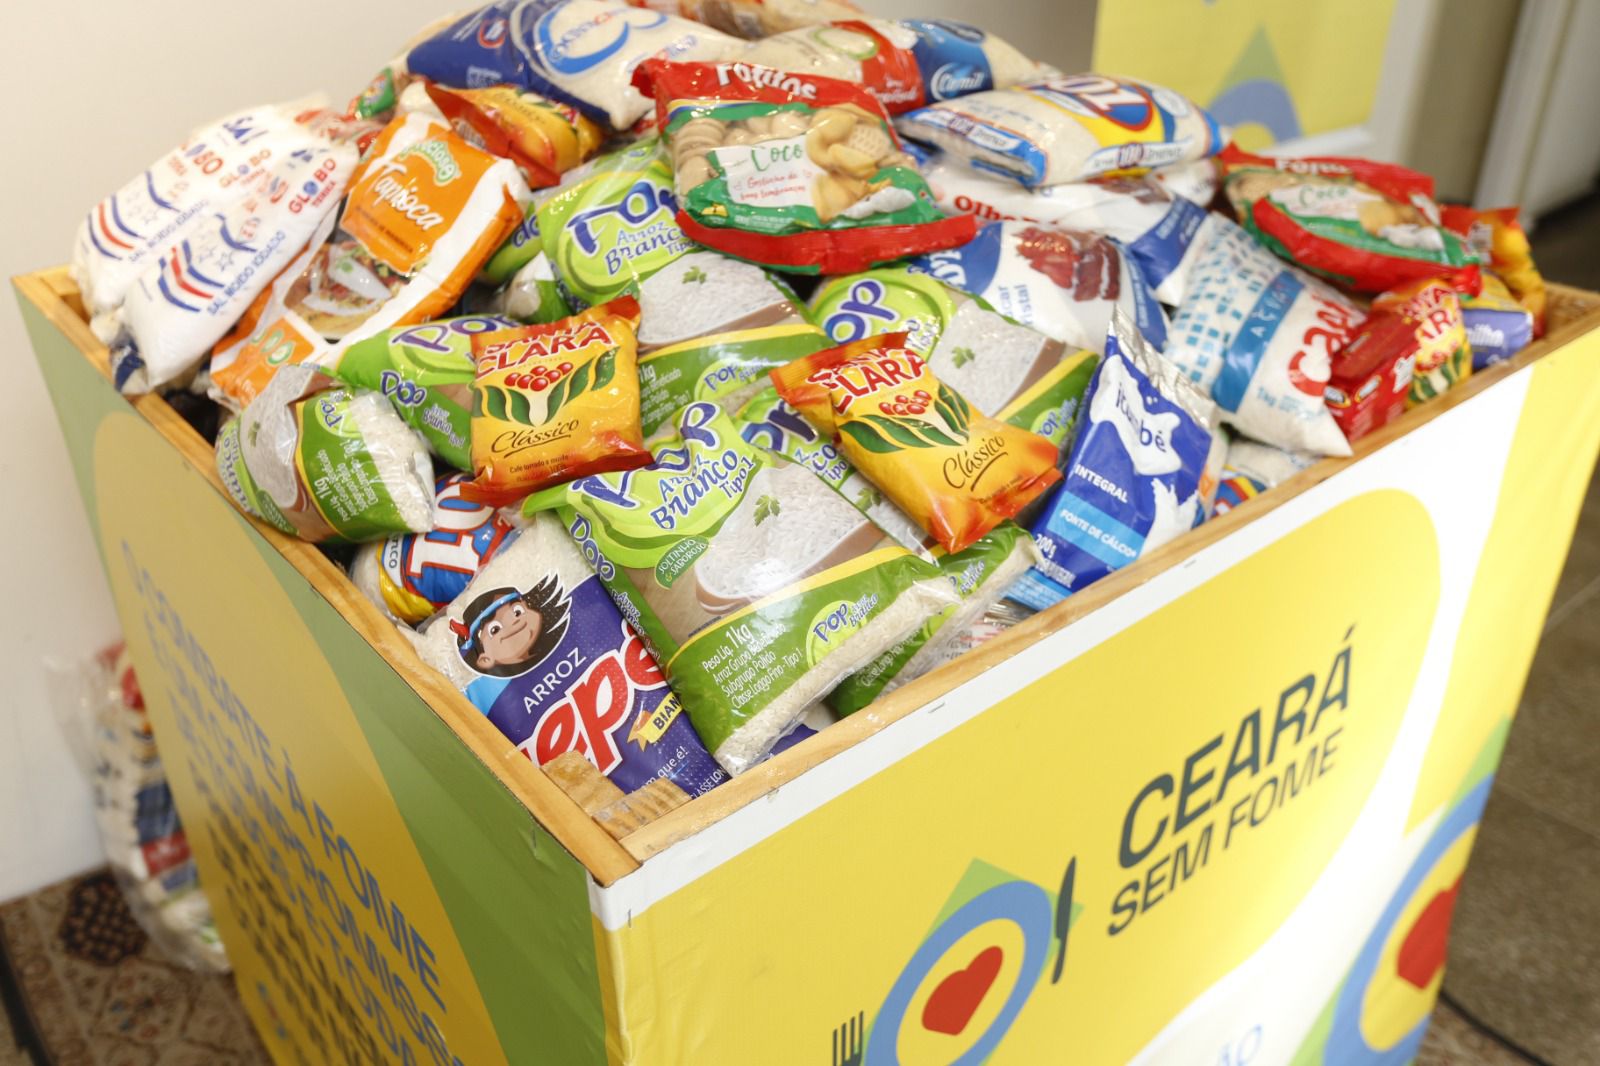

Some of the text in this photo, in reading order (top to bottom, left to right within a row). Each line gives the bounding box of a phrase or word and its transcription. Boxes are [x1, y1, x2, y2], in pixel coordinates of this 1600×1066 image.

[751, 143, 804, 172] Coco
[288, 159, 337, 214] GLOBO
[366, 163, 444, 231] Tapioca
[474, 327, 614, 382] CLARA
[491, 419, 580, 453] Clássico
[943, 434, 1006, 490] Clássico
[650, 449, 739, 531] Branco
[1074, 464, 1128, 503] INTEGRAL
[1060, 508, 1089, 532] FONTE
[1087, 525, 1103, 540] DE
[702, 654, 720, 673] Peso
[725, 623, 756, 649] 1kg
[713, 666, 733, 686] Arroz
[729, 651, 752, 672] Grupo
[522, 648, 588, 715] ARROZ
[721, 667, 756, 698] Subgrupo
[732, 688, 754, 709] Classe
[657, 757, 679, 779] que
[1118, 623, 1357, 870] CEARÁ
[1107, 726, 1345, 937] SEM FOME
[312, 799, 447, 1015] FOME
